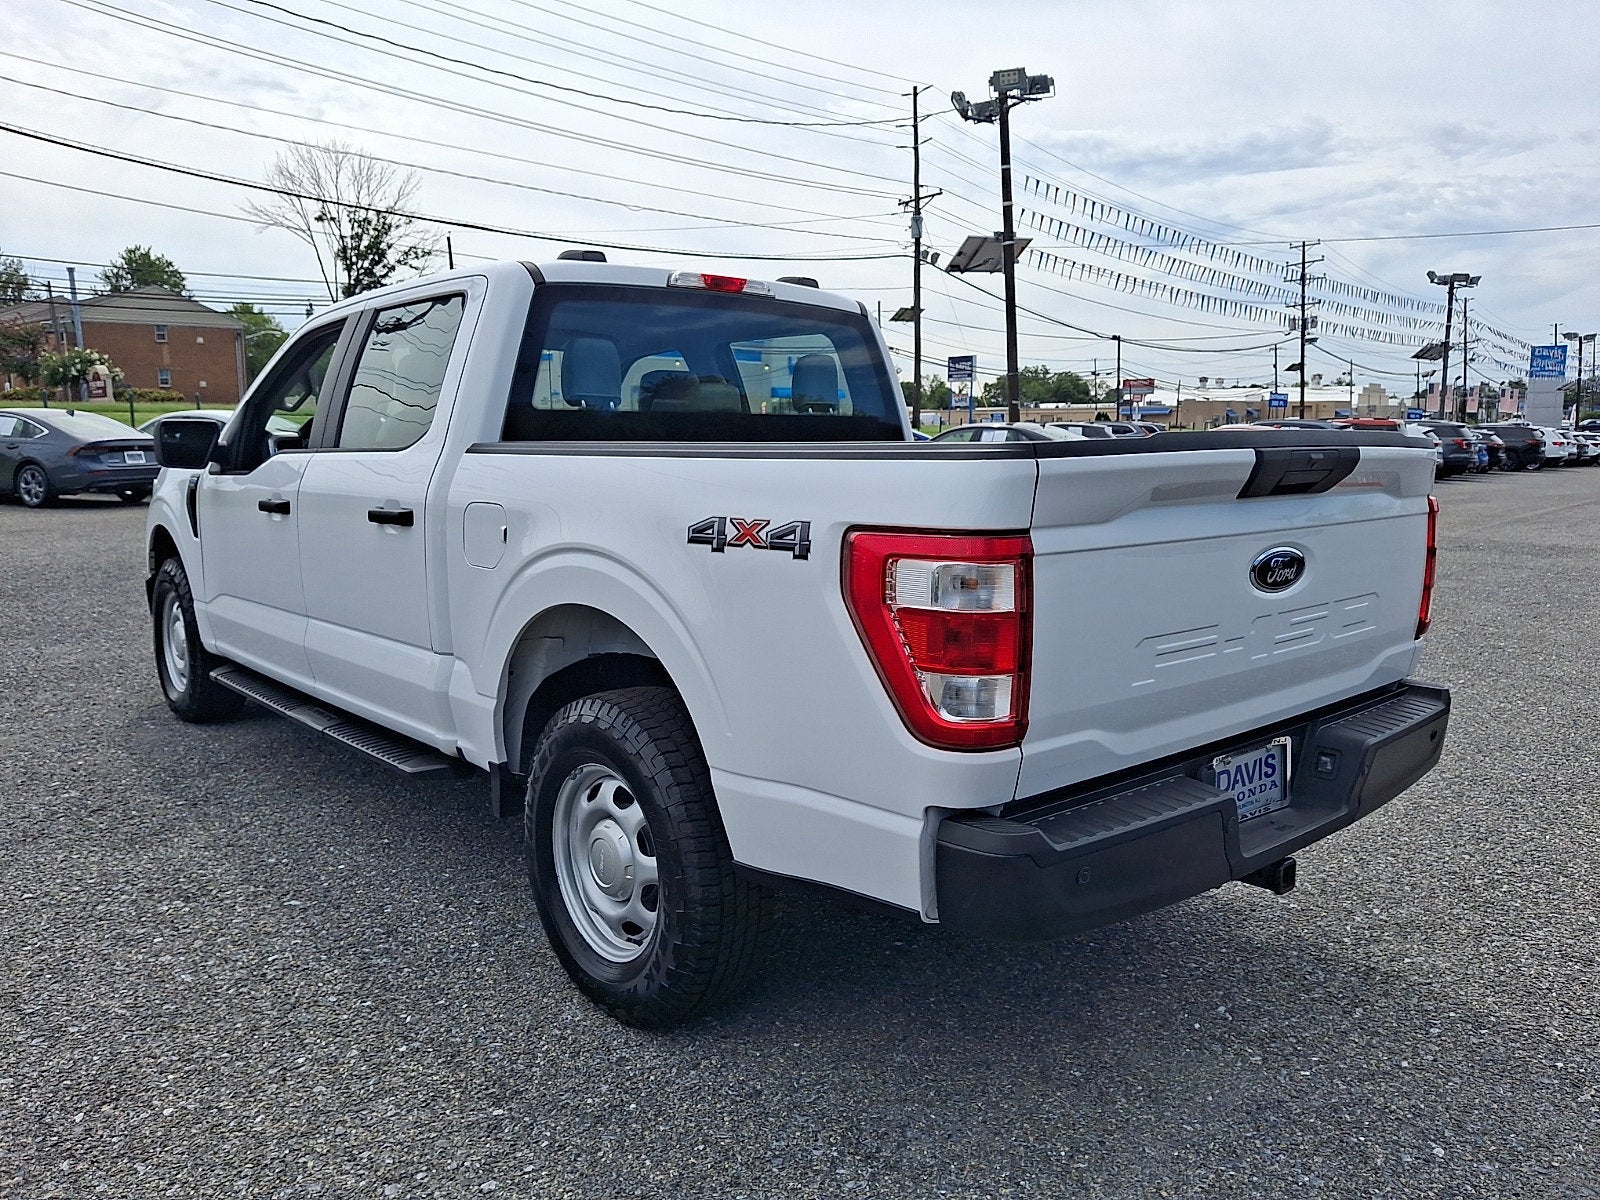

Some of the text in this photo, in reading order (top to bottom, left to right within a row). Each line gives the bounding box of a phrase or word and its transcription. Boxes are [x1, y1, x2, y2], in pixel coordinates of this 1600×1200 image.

[1266, 556, 1298, 584] Ford
[1131, 592, 1380, 688] F-150
[1217, 754, 1276, 791] DAVIS
[1234, 780, 1279, 802] ONDA
[1240, 806, 1271, 820] AVIS
